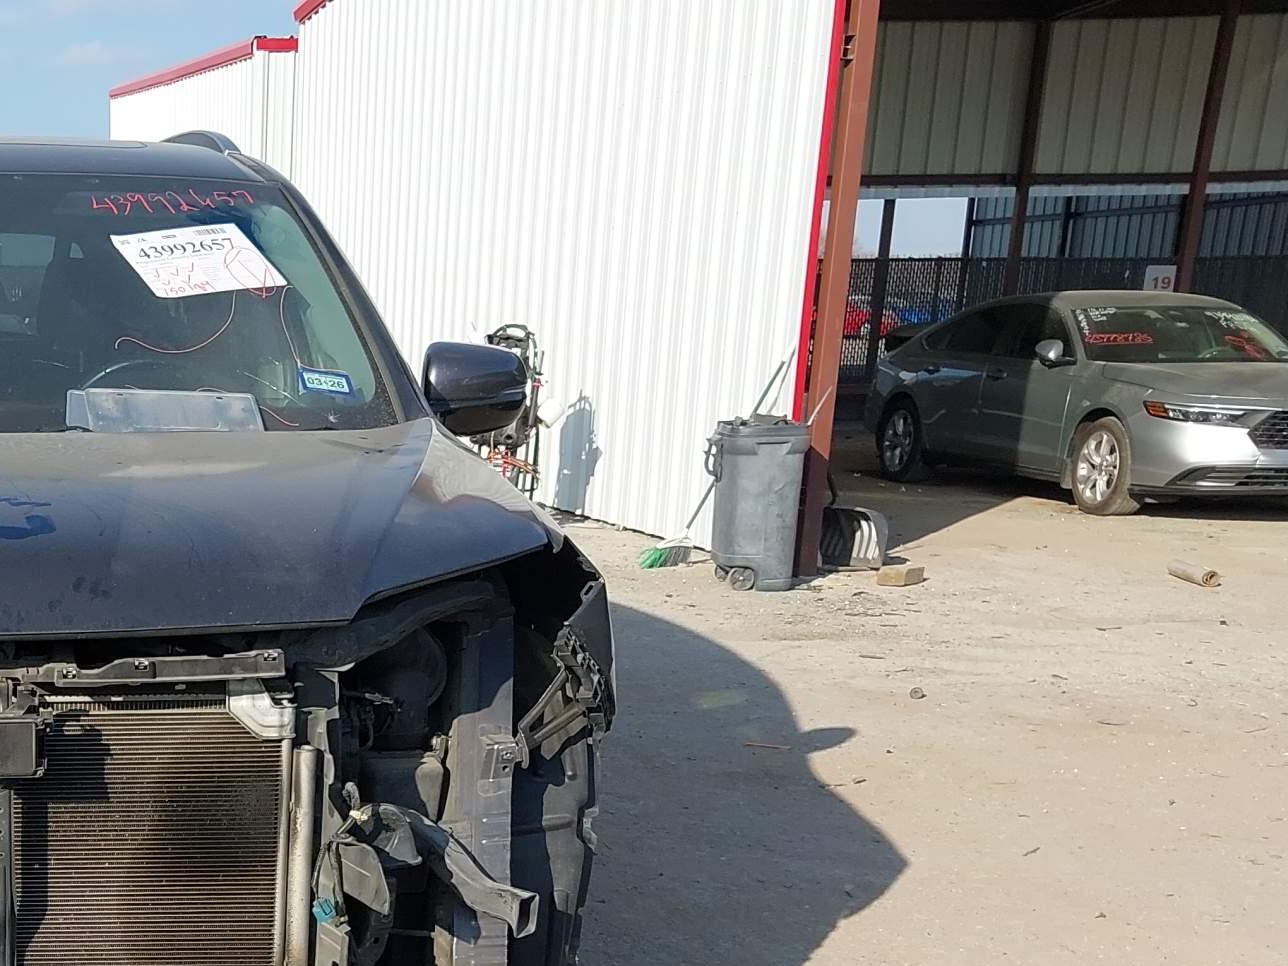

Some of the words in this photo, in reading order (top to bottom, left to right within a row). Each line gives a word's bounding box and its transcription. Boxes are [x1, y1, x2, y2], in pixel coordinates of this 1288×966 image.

[91, 188, 255, 216] 43992657
[137, 237, 235, 260] 43992657
[1152, 276, 1172, 290] 19
